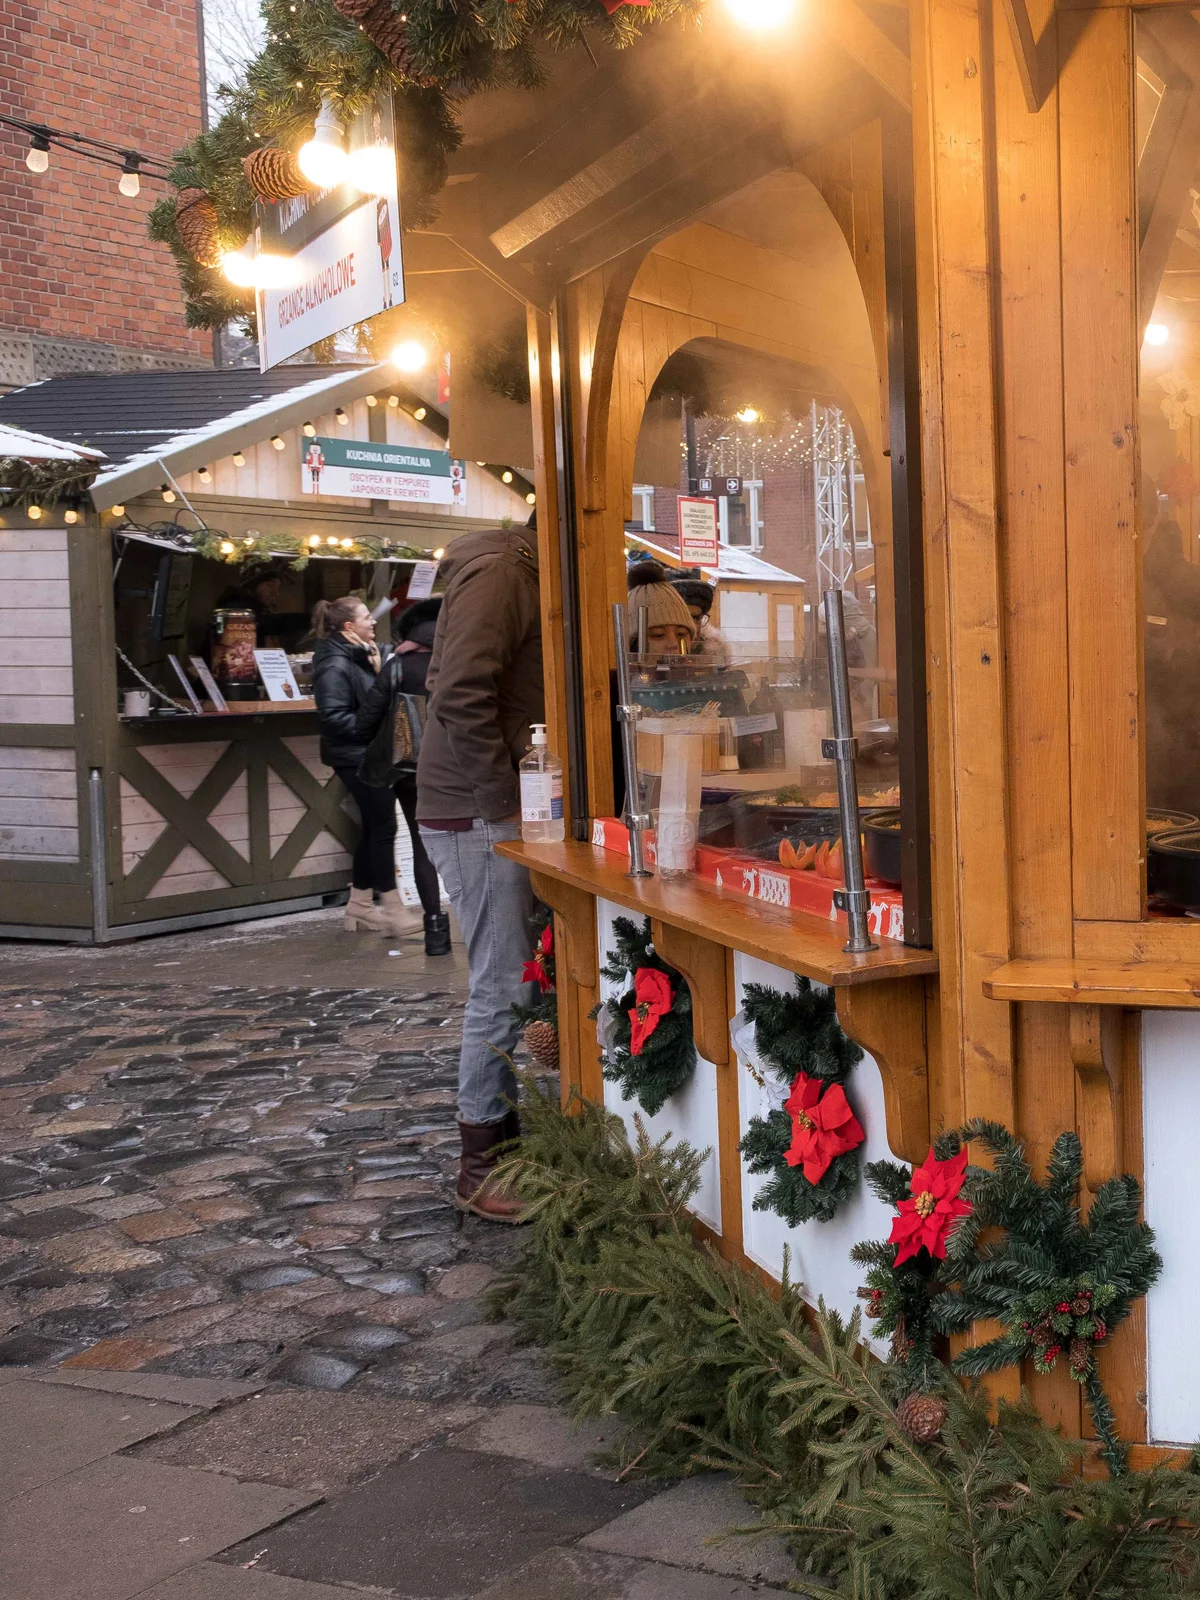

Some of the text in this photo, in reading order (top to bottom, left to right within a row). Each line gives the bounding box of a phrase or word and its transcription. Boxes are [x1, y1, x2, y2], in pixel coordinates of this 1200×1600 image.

[305, 252, 355, 314] ALKOHOLOWE
[346, 449, 432, 468] KUCHNIA ORIENTALNA
[349, 472, 430, 488] OSCYPEK W TEMPURZE
[393, 488, 430, 498] KREWETKI
